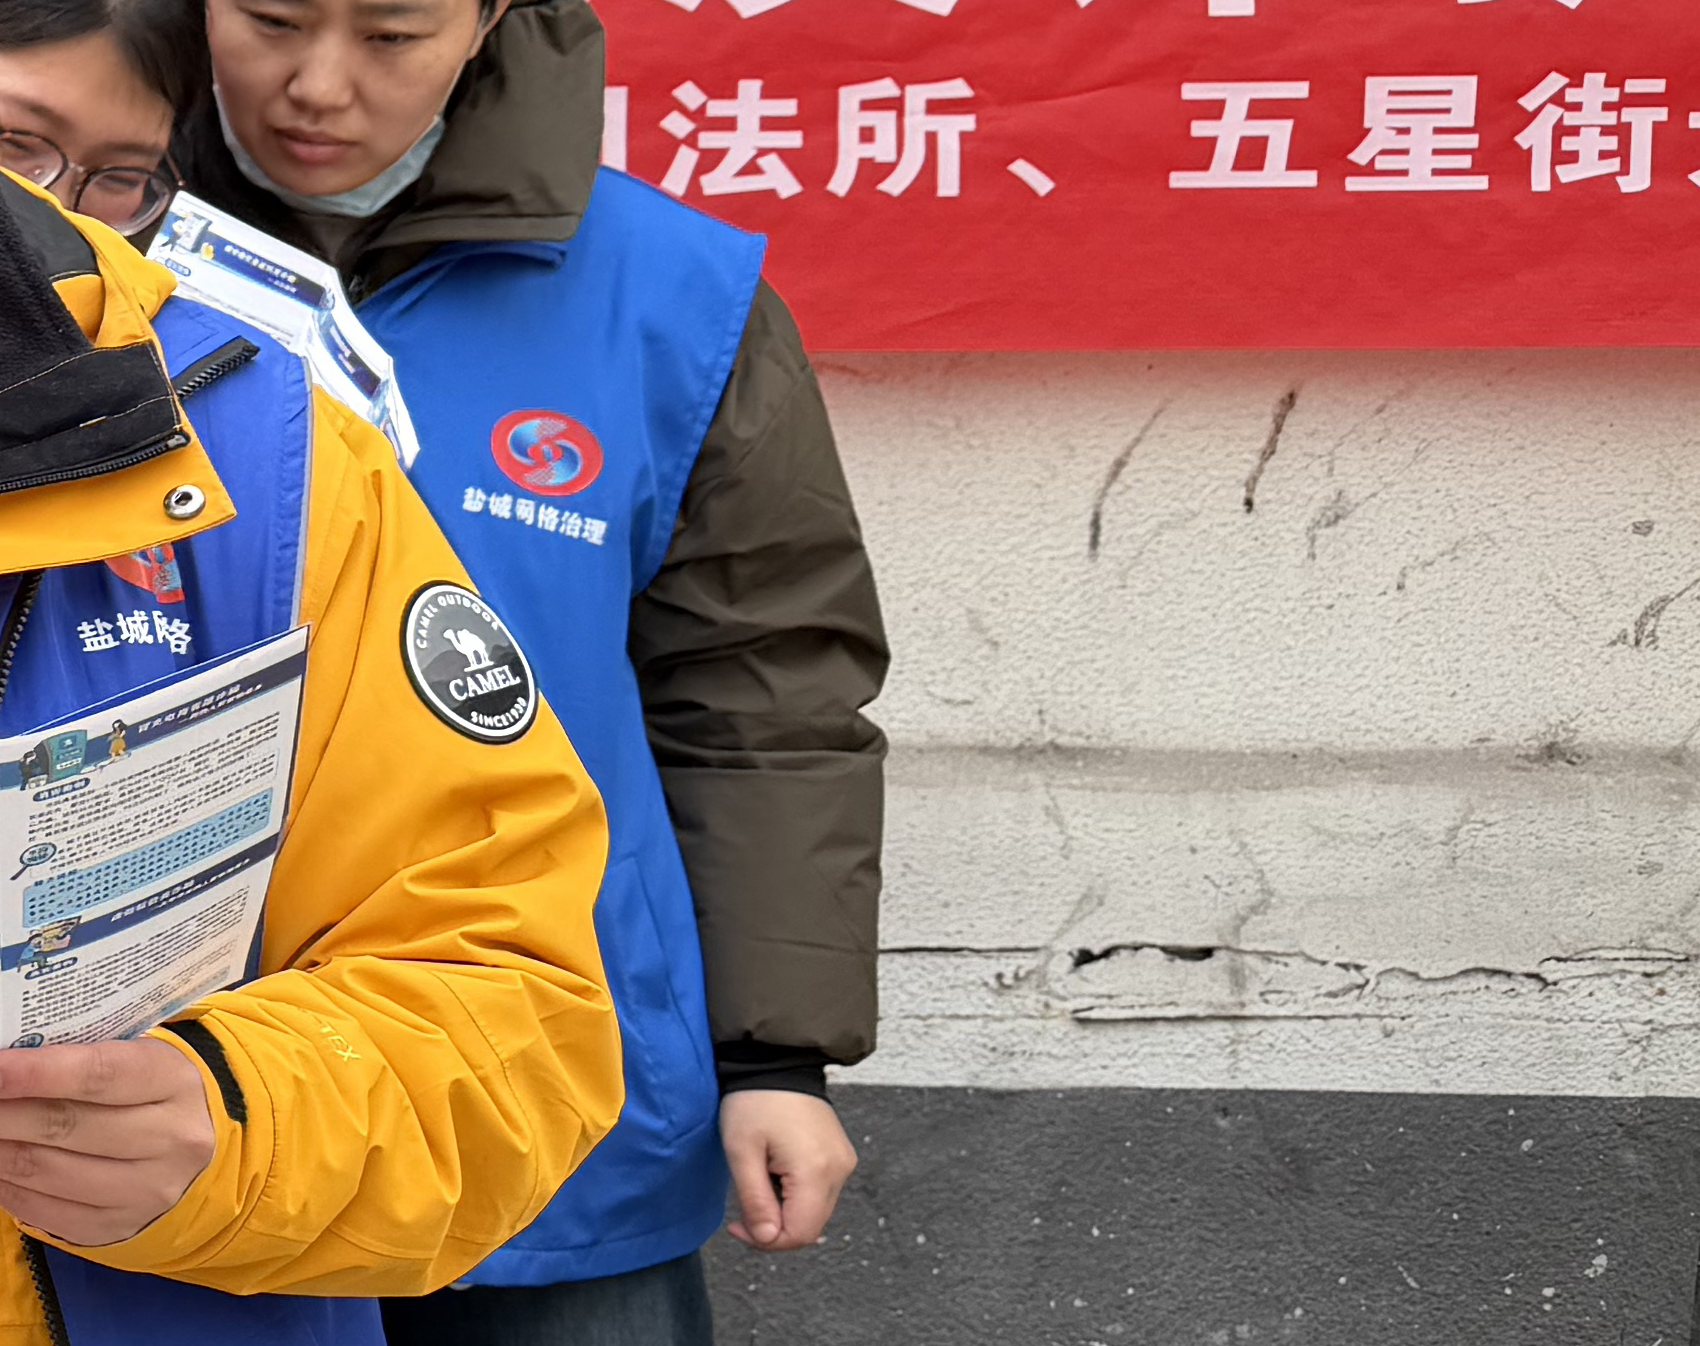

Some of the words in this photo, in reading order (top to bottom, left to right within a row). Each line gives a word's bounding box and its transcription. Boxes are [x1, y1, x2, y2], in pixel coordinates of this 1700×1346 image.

[462, 485, 608, 546] 盐城网格治理
[415, 604, 439, 649] CAMEL
[448, 664, 521, 702] CAMEL
